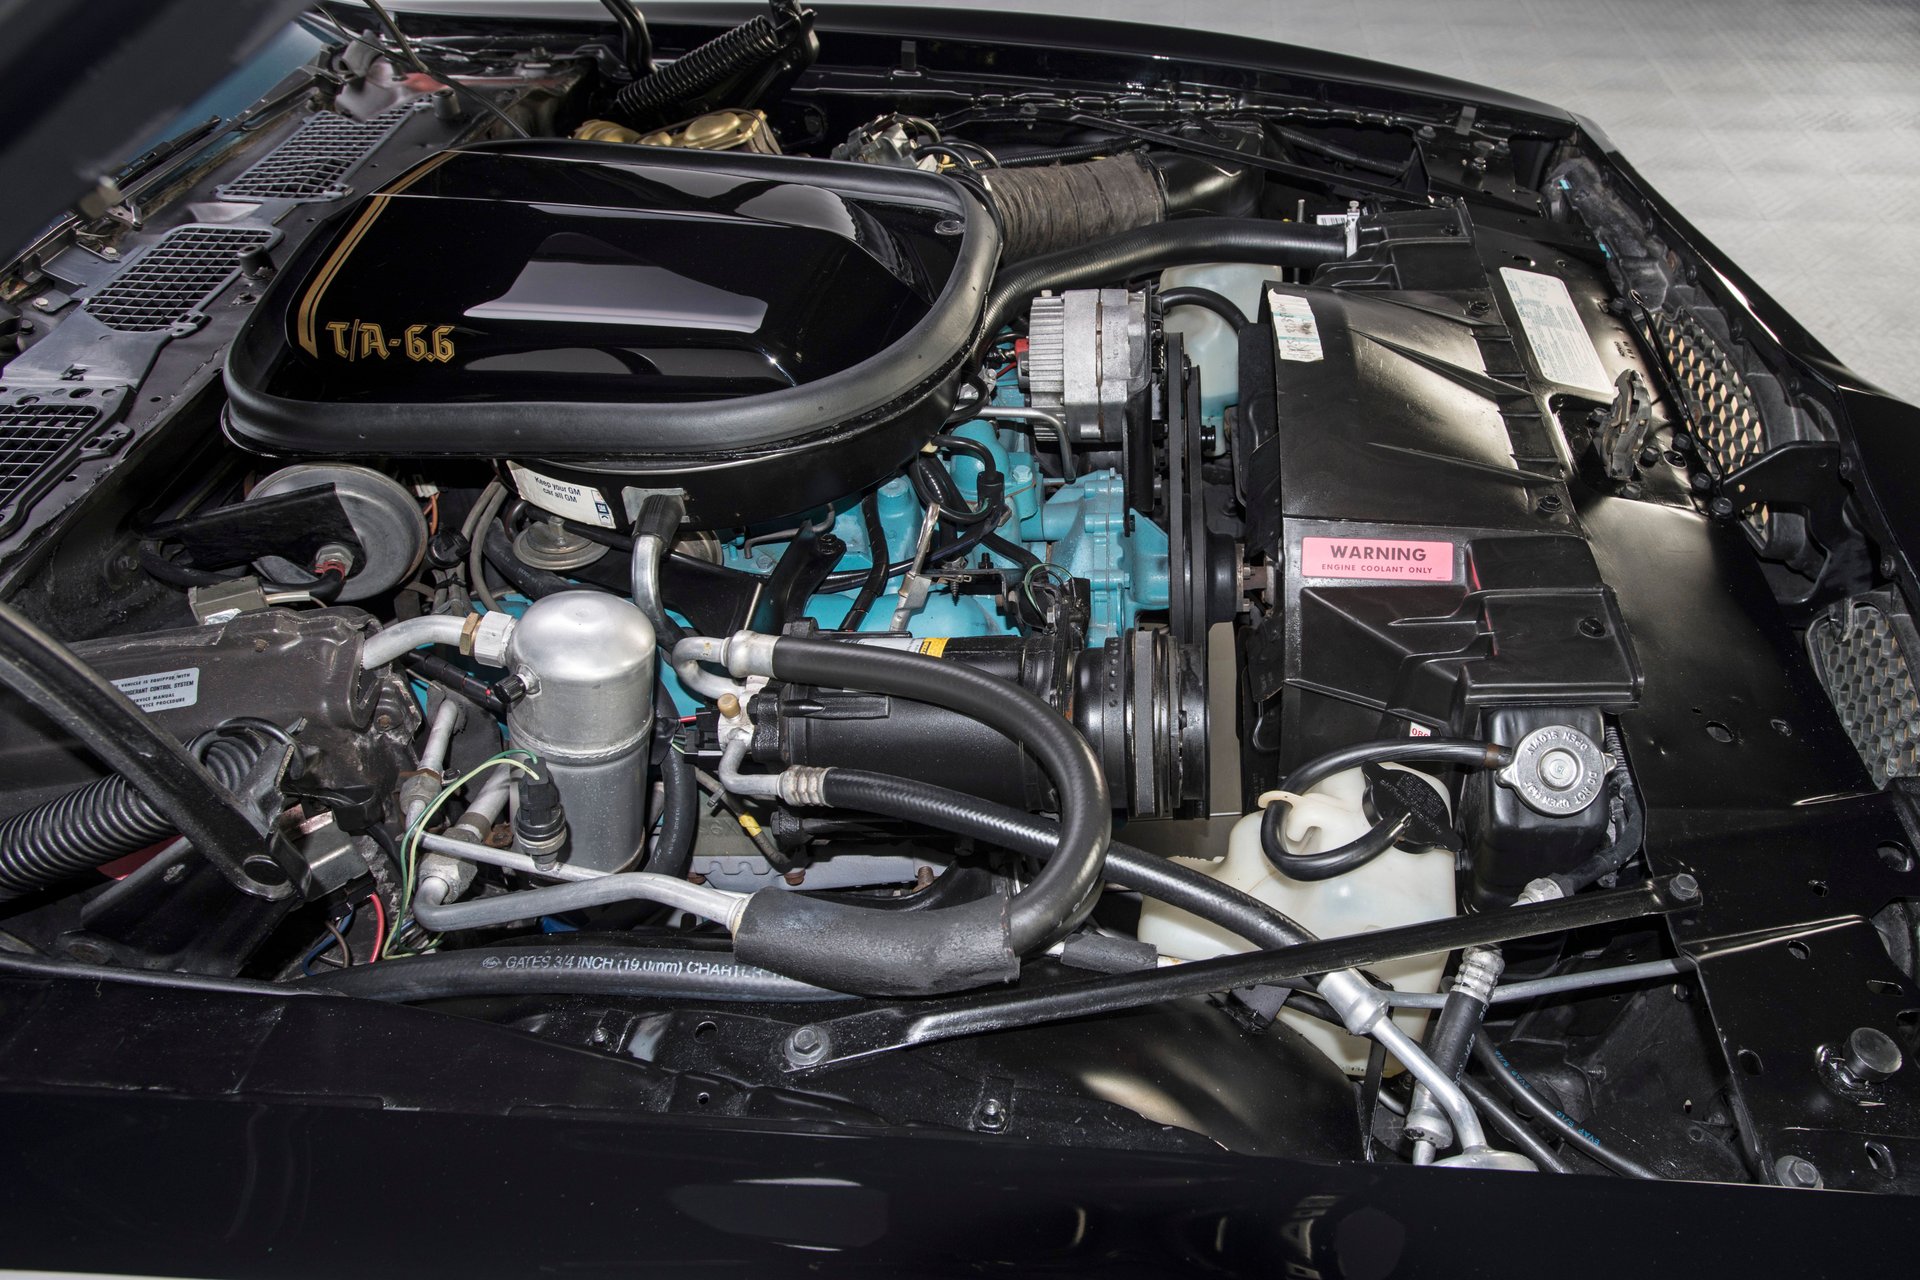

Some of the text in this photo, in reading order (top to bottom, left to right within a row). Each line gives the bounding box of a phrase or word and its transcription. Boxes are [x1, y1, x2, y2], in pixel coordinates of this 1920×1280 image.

[325, 318, 455, 363] T/A-6.6
[535, 476, 581, 496] Keep your GM
[543, 487, 578, 503] car all GM
[1330, 545, 1427, 562] WARNING
[1321, 563, 1433, 574] ENGINE COOLANT ONLY
[150, 675, 175, 684] EQUIPPED
[150, 683, 172, 692] CONTROL
[174, 680, 194, 688] SYSTEM
[156, 697, 185, 705] PROCEDURE
[1526, 730, 1589, 756] OPEN SLOWLY
[1587, 771, 1598, 785] DO
[1542, 795, 1570, 808] OPEN
[1574, 786, 1593, 805] NOT
[505, 955, 551, 969] GATES
[553, 955, 576, 969] 3/4
[577, 956, 614, 970] INCH
[1577, 1128, 1601, 1147] EVAP
